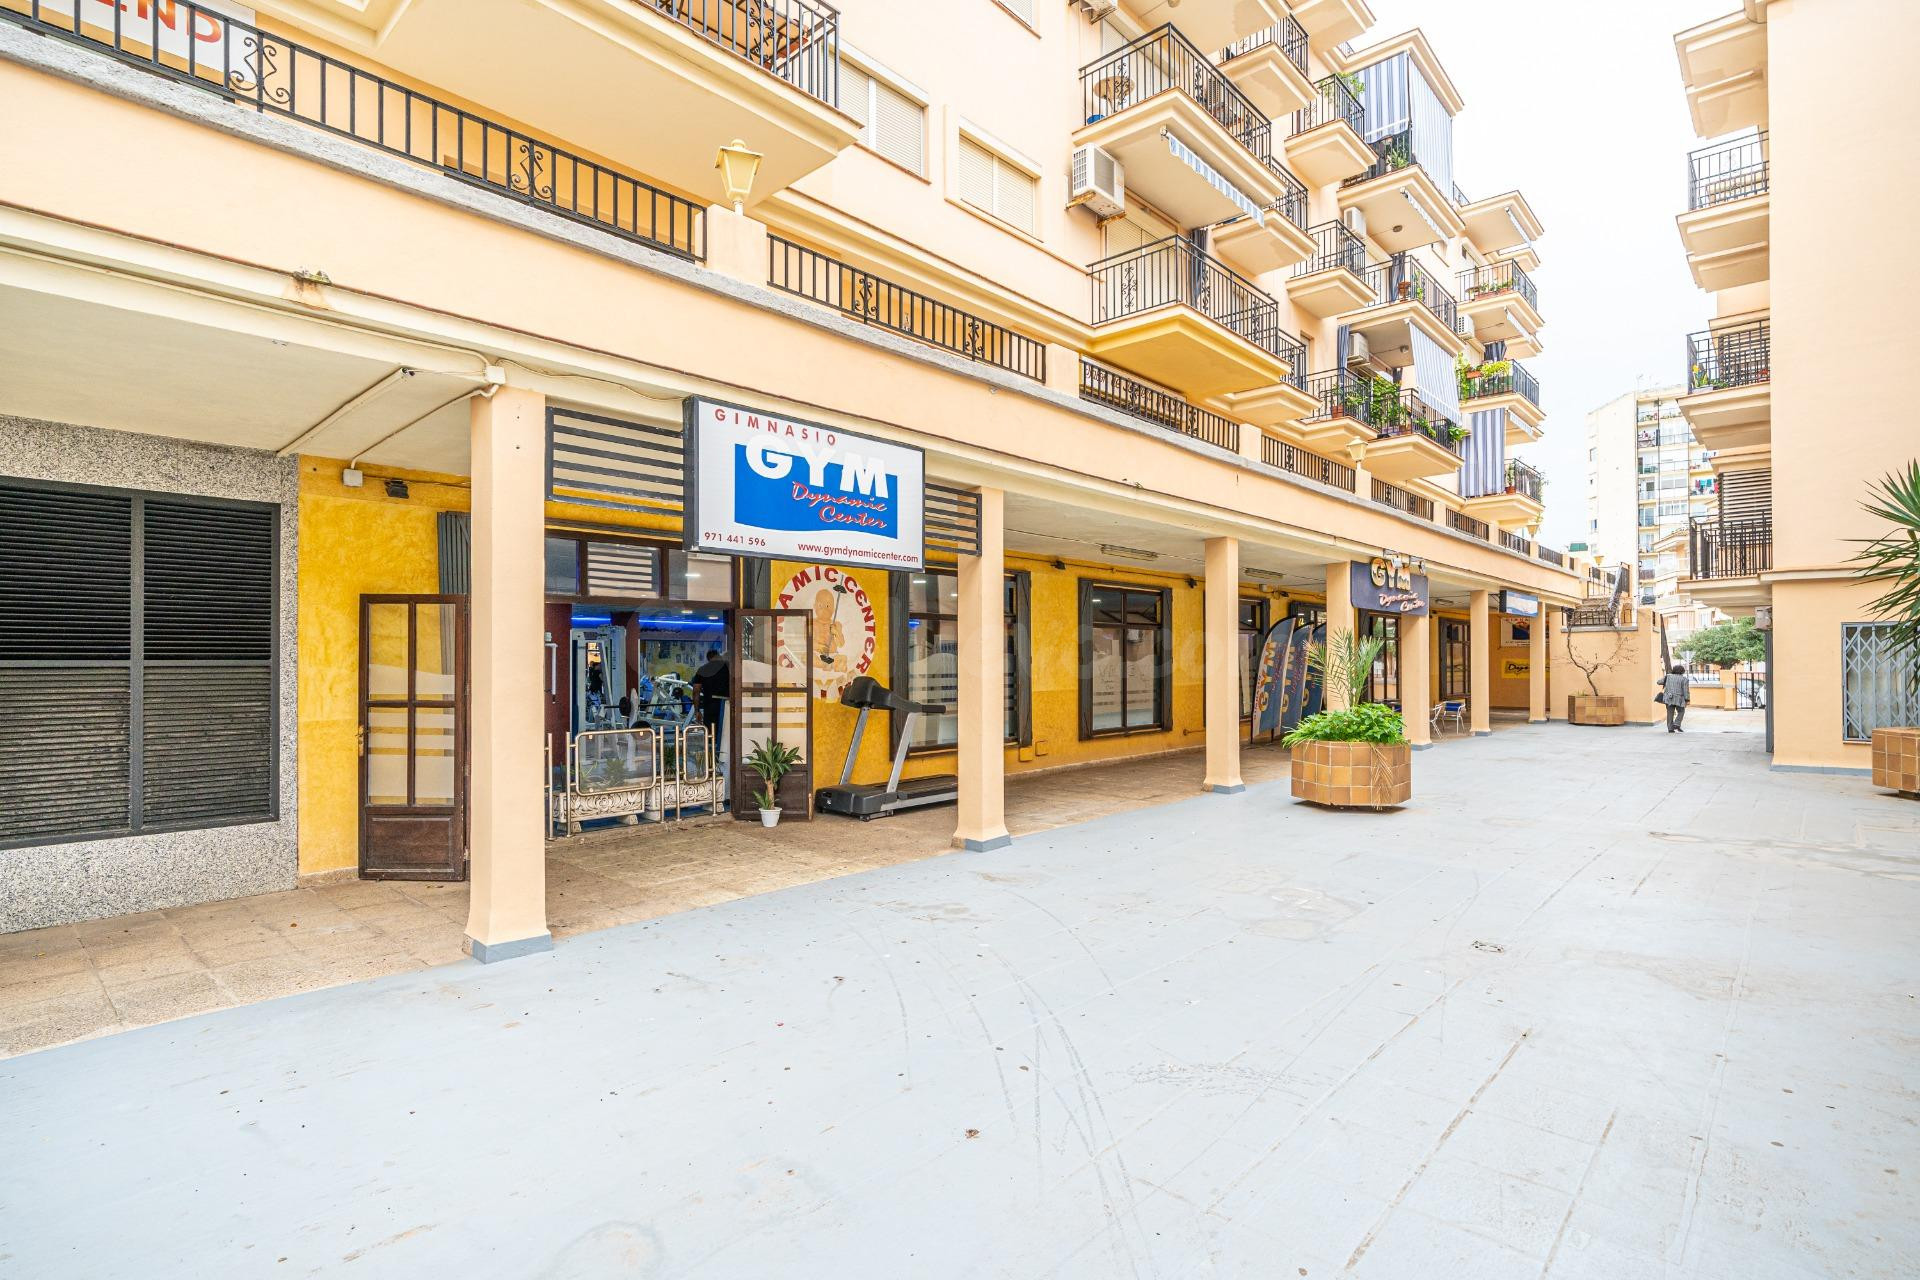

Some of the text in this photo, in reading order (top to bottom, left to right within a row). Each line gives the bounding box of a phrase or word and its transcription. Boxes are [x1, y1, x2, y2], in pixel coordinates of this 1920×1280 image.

[95, 0, 222, 43] ND
[714, 408, 837, 446] GIMNASIO
[745, 434, 889, 499] GYM
[791, 480, 888, 512] Dynamic
[818, 505, 888, 529] Center
[704, 531, 767, 547] 971 441 596
[797, 542, 919, 563] www.gymdynamiccenter.com
[1370, 557, 1412, 591] GYM
[844, 576, 876, 674] CENTER
[1259, 641, 1277, 712] GYM
